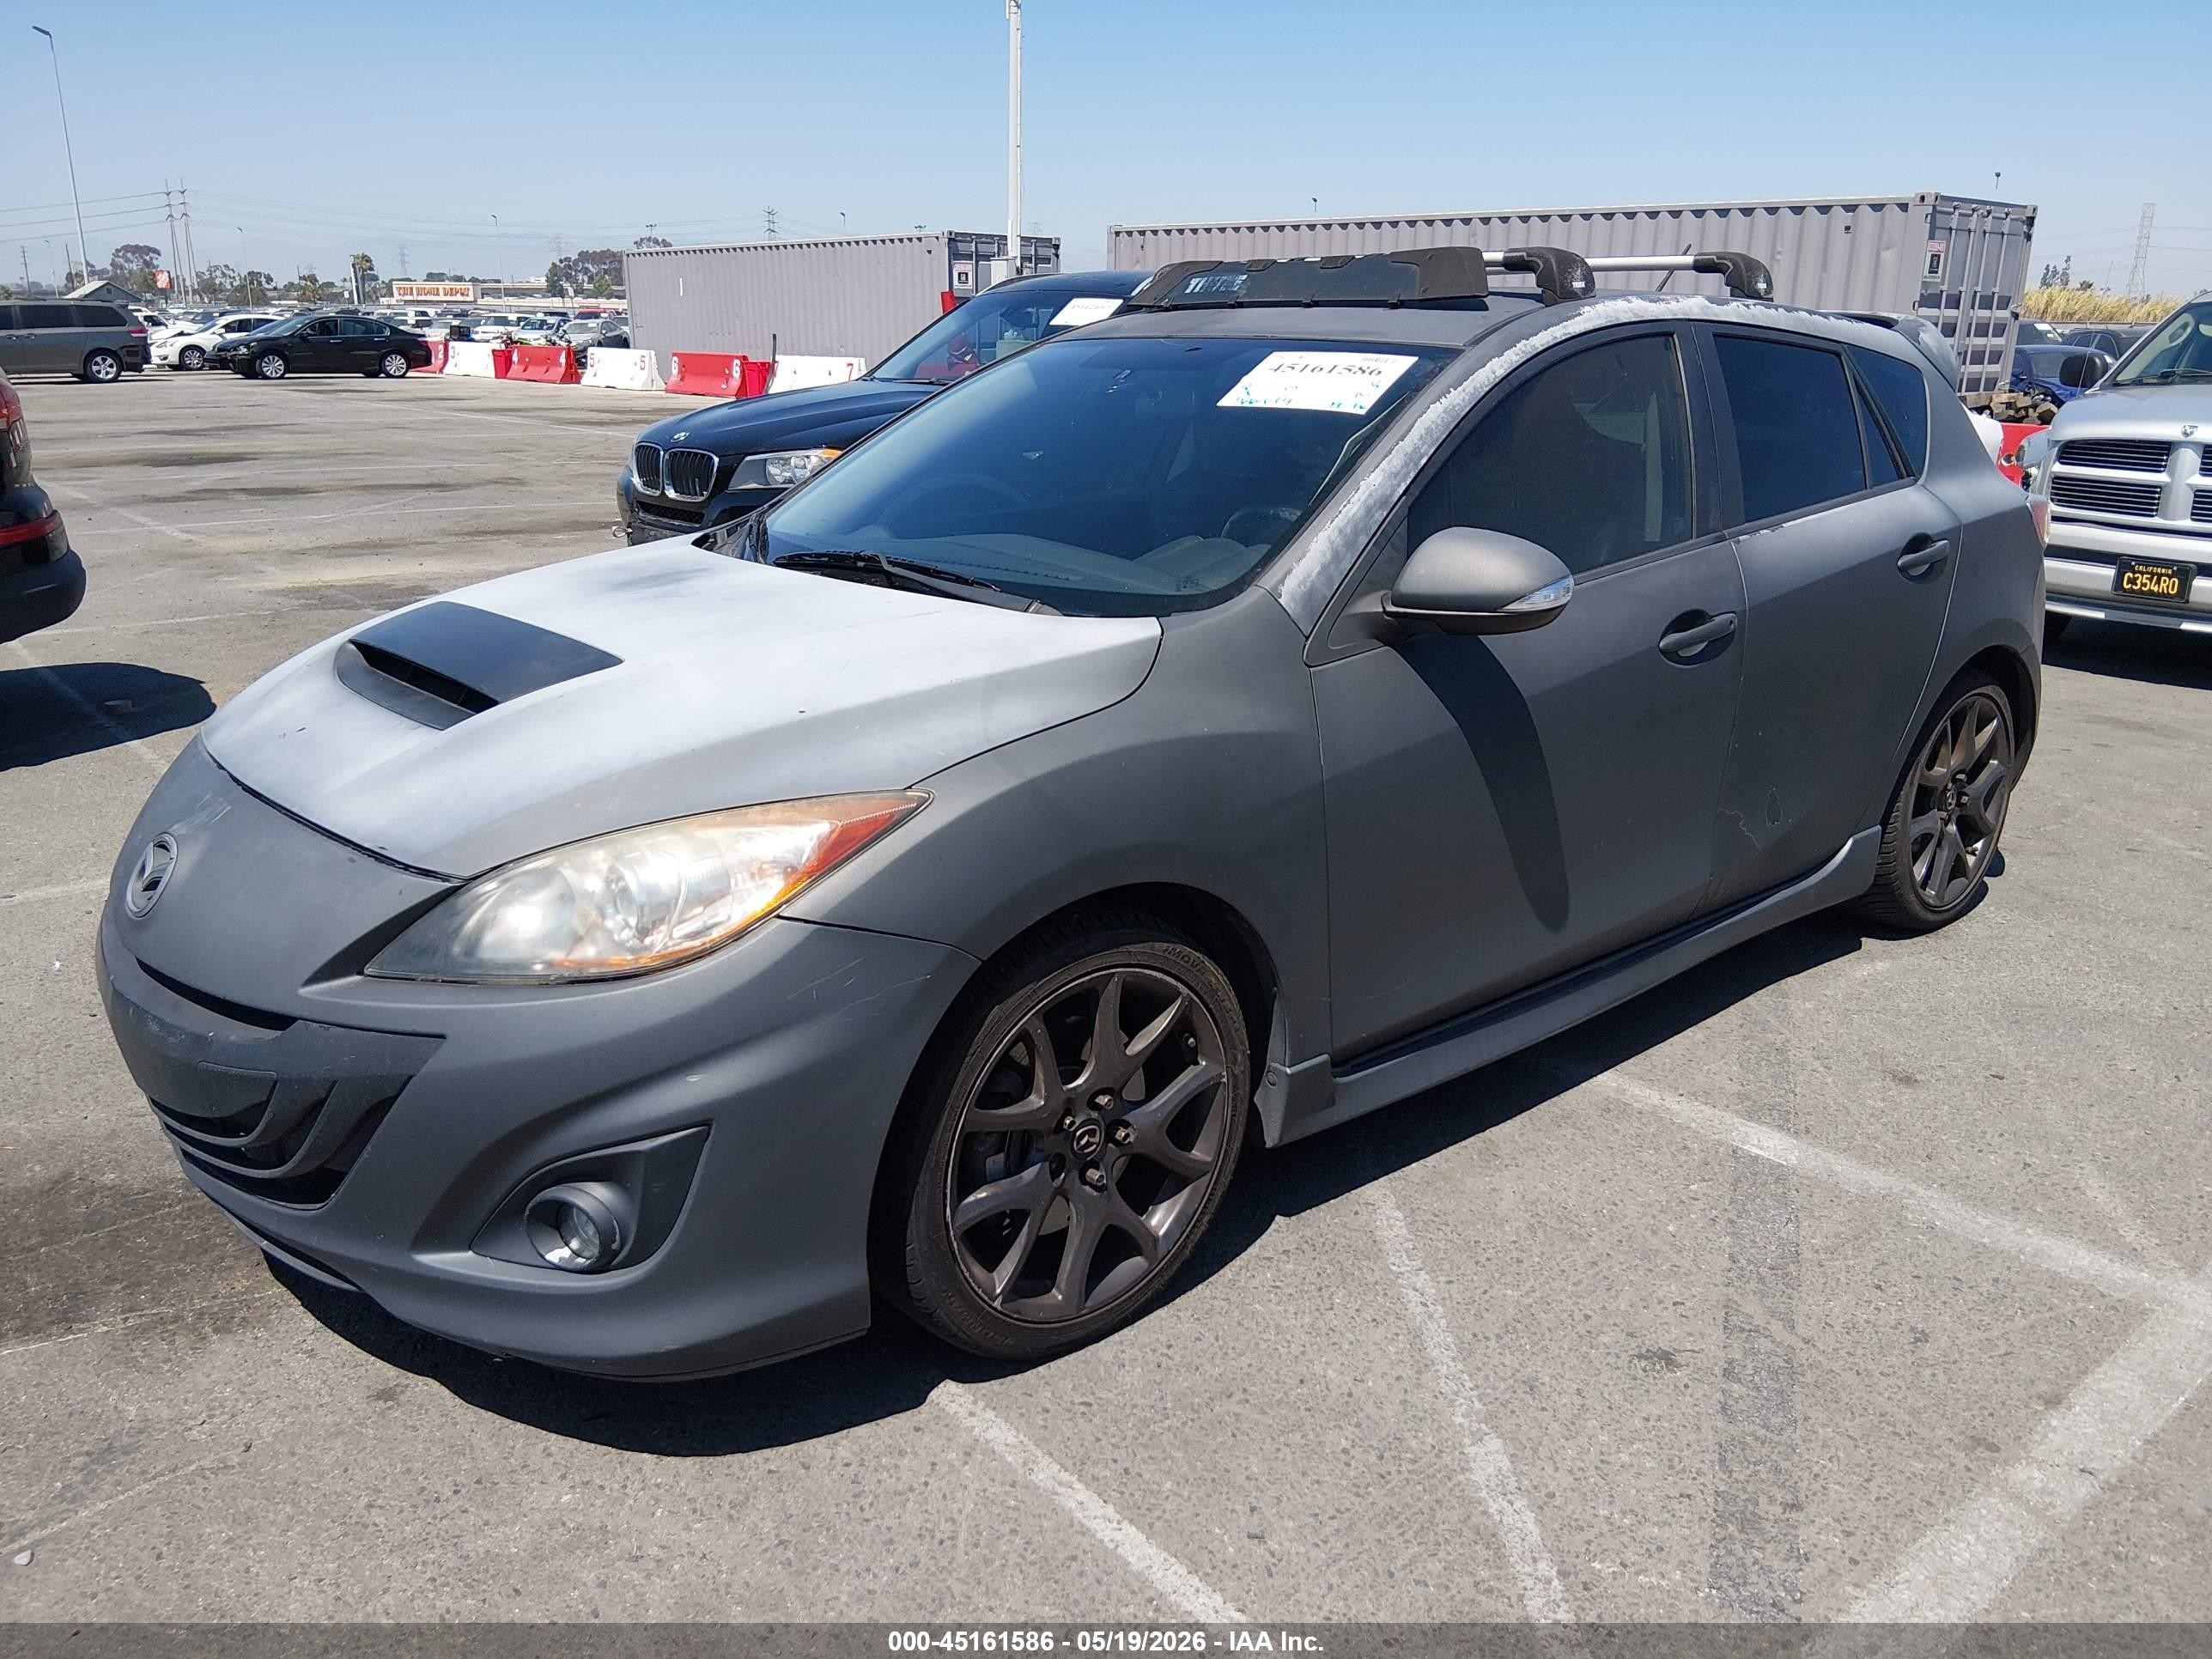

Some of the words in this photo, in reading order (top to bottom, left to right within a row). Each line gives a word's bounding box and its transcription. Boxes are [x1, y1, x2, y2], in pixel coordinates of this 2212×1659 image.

[396, 287, 413, 296] THE
[416, 287, 440, 296] HOME
[442, 287, 470, 297] DEPOT
[512, 348, 519, 365] 4
[559, 349, 567, 367] 4
[589, 353, 595, 368] 5
[639, 355, 646, 370] 5
[672, 356, 679, 376] 6
[732, 359, 741, 379] 6
[847, 362, 854, 381] 7
[1268, 362, 1382, 377] 45161586
[2135, 564, 2172, 574] CALIFORNIA
